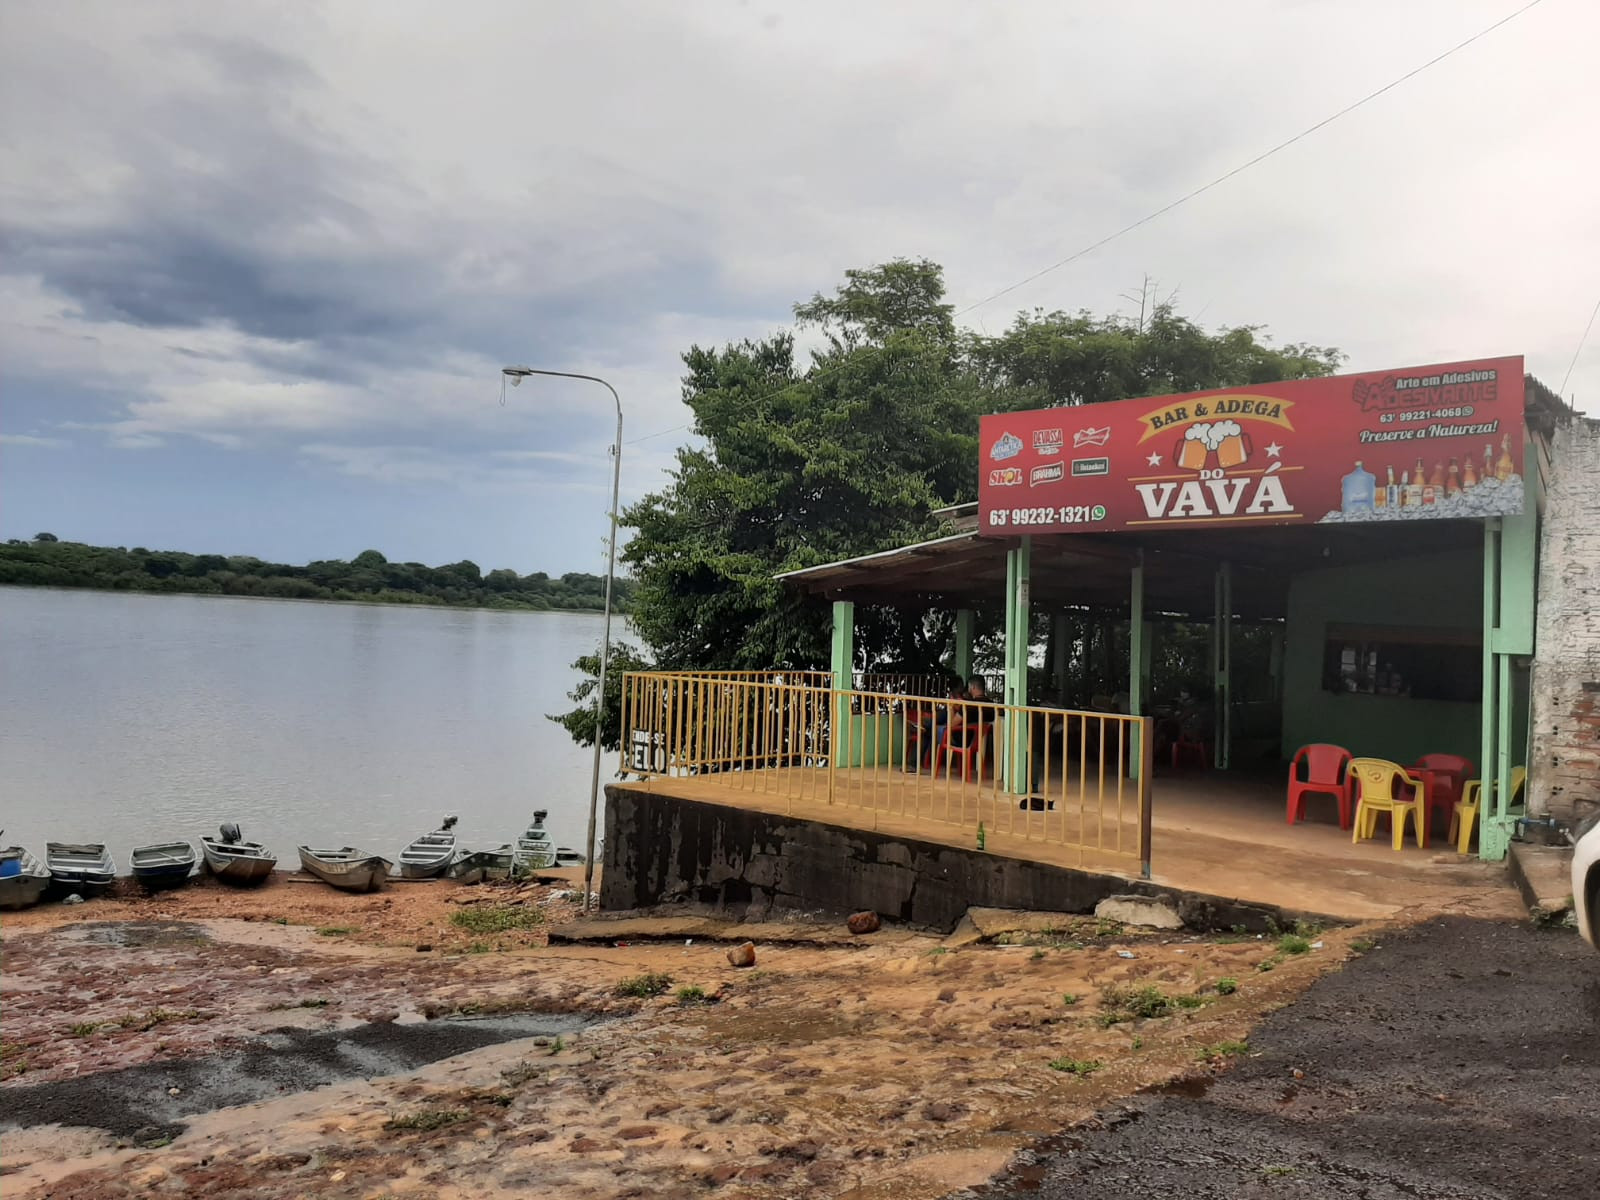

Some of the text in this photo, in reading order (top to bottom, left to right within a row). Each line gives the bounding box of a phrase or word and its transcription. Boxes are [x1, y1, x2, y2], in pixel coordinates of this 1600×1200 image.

[1396, 370, 1496, 389] Arte em Adesivos
[1150, 399, 1282, 430] BAR & ADEGA
[1399, 407, 1461, 422] 99221-4068
[1033, 430, 1062, 444] DEVASSA
[1359, 420, 1499, 443] Preserve a Natureza!
[990, 469, 1021, 485] SKOL
[1032, 467, 1061, 481] BRAHMA
[1199, 468, 1225, 480] DO
[1135, 461, 1294, 518] VAVÁ
[1011, 506, 1090, 525] 99232-1321
